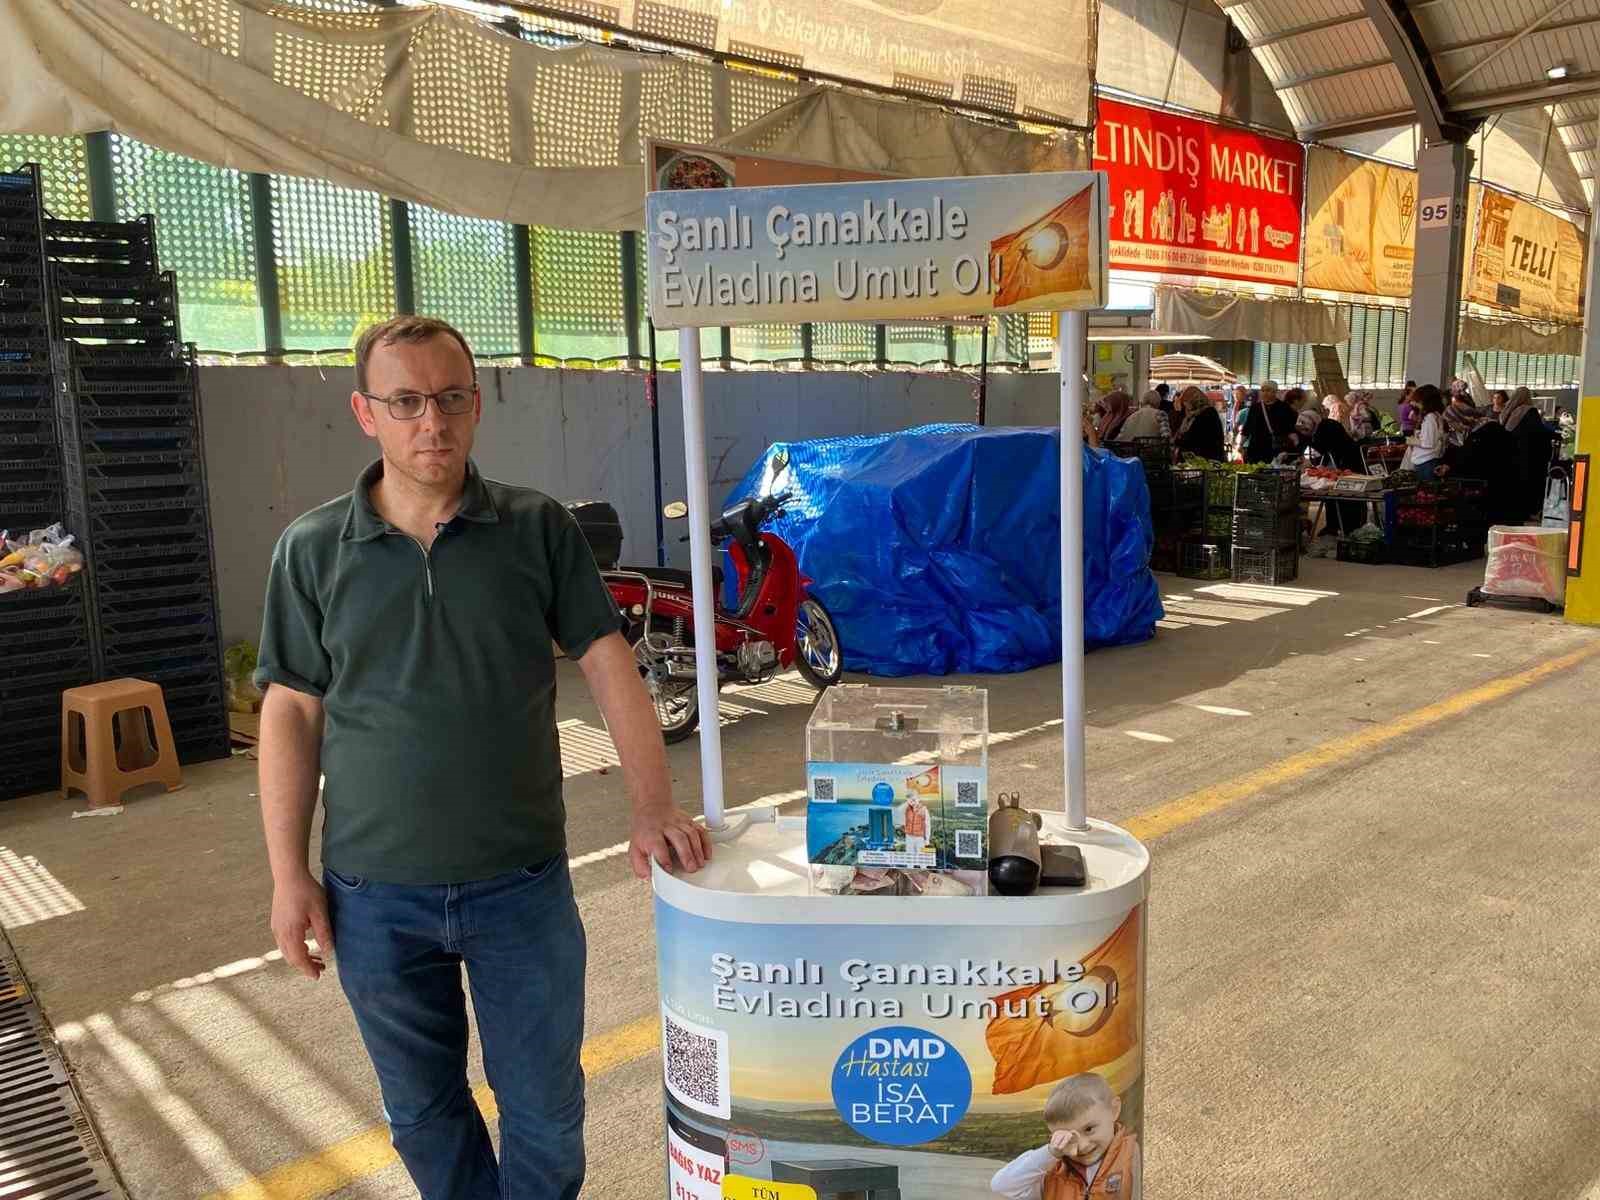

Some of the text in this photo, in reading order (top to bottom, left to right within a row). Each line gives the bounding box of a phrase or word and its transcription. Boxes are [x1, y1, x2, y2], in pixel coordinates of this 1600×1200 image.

[1211, 143, 1297, 196] MARKET
[1422, 204, 1448, 221] 95
[657, 196, 968, 265] Şanlı Çanakkale
[1510, 234, 1558, 280] TELLİ
[662, 260, 819, 308] Evladına
[834, 256, 939, 301] Umut
[711, 952, 1086, 992] Şanlı Çanakkale
[712, 983, 904, 1019] Evladına
[921, 991, 1050, 1020] Umut
[1066, 980, 1119, 1014] Ol!
[869, 1038, 946, 1059] DMD
[841, 1049, 930, 1077] Hastası
[878, 1077, 927, 1103] İSA
[852, 1103, 955, 1124] BERAT
[730, 1139, 756, 1156] SMS
[697, 1163, 721, 1185] YAZ
[751, 1185, 779, 1200] TÜM
